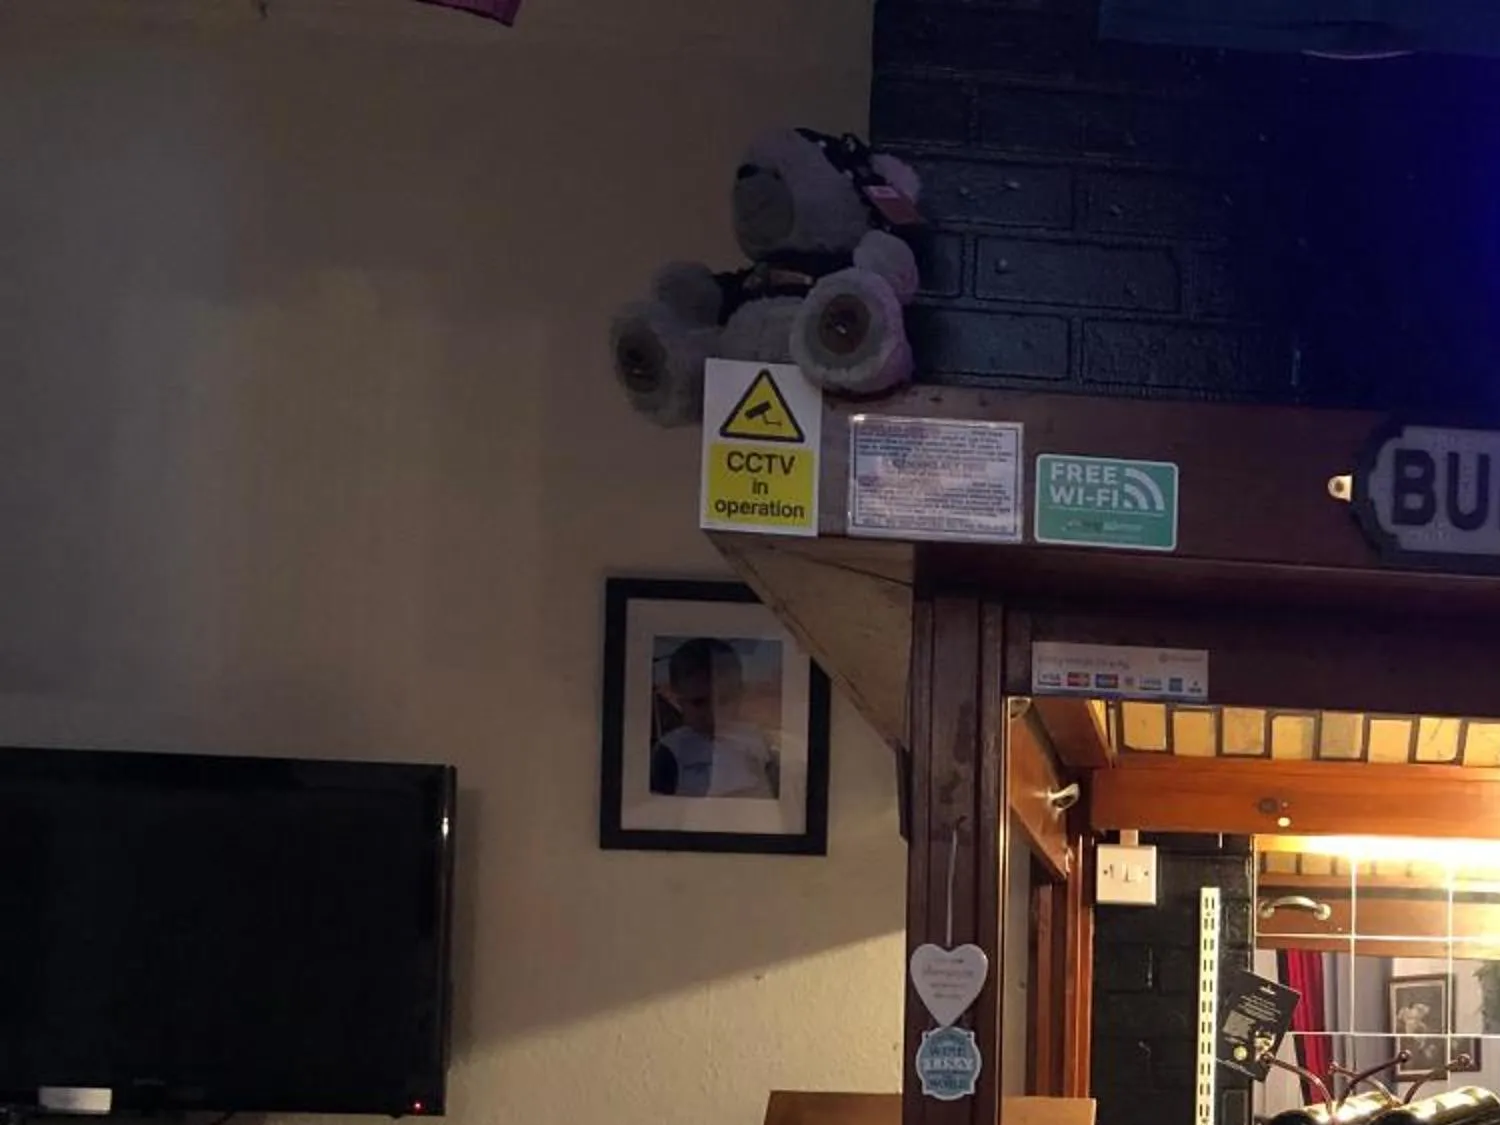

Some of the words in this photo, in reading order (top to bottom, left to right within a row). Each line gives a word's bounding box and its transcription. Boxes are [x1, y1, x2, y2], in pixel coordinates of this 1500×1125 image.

[727, 451, 796, 475] CCTV
[1051, 462, 1118, 485] FREE
[752, 478, 769, 495] in
[1050, 483, 1119, 509] WI-FI
[715, 499, 806, 519] operation
